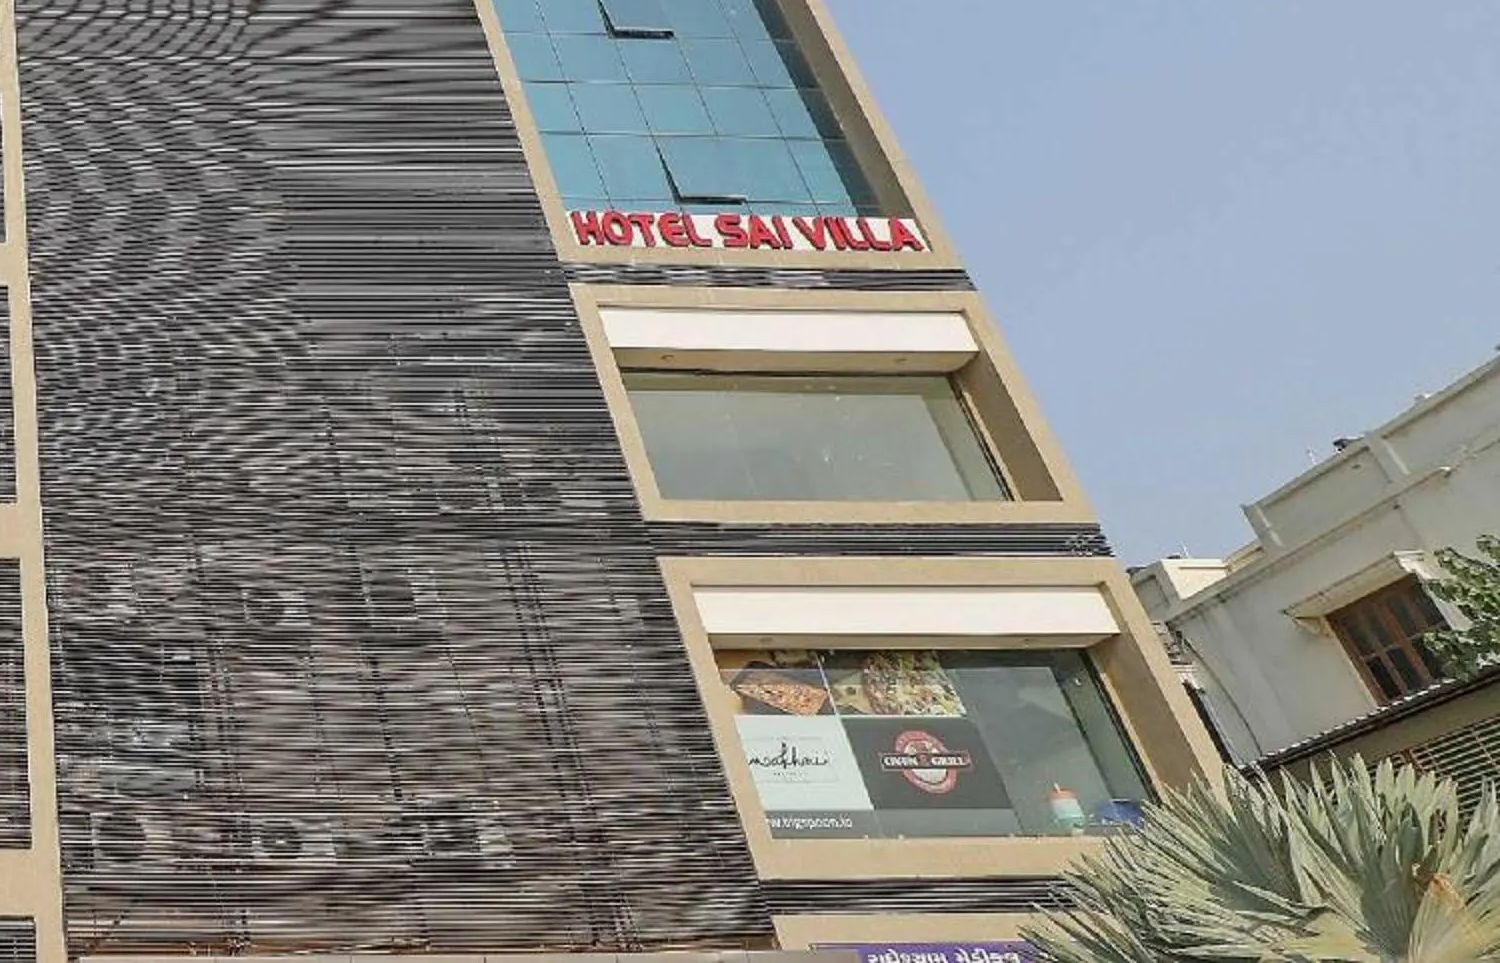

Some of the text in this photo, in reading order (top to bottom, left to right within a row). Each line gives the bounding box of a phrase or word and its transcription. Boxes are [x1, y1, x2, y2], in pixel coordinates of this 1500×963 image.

[570, 211, 925, 252] HOTEL SAI VILLA
